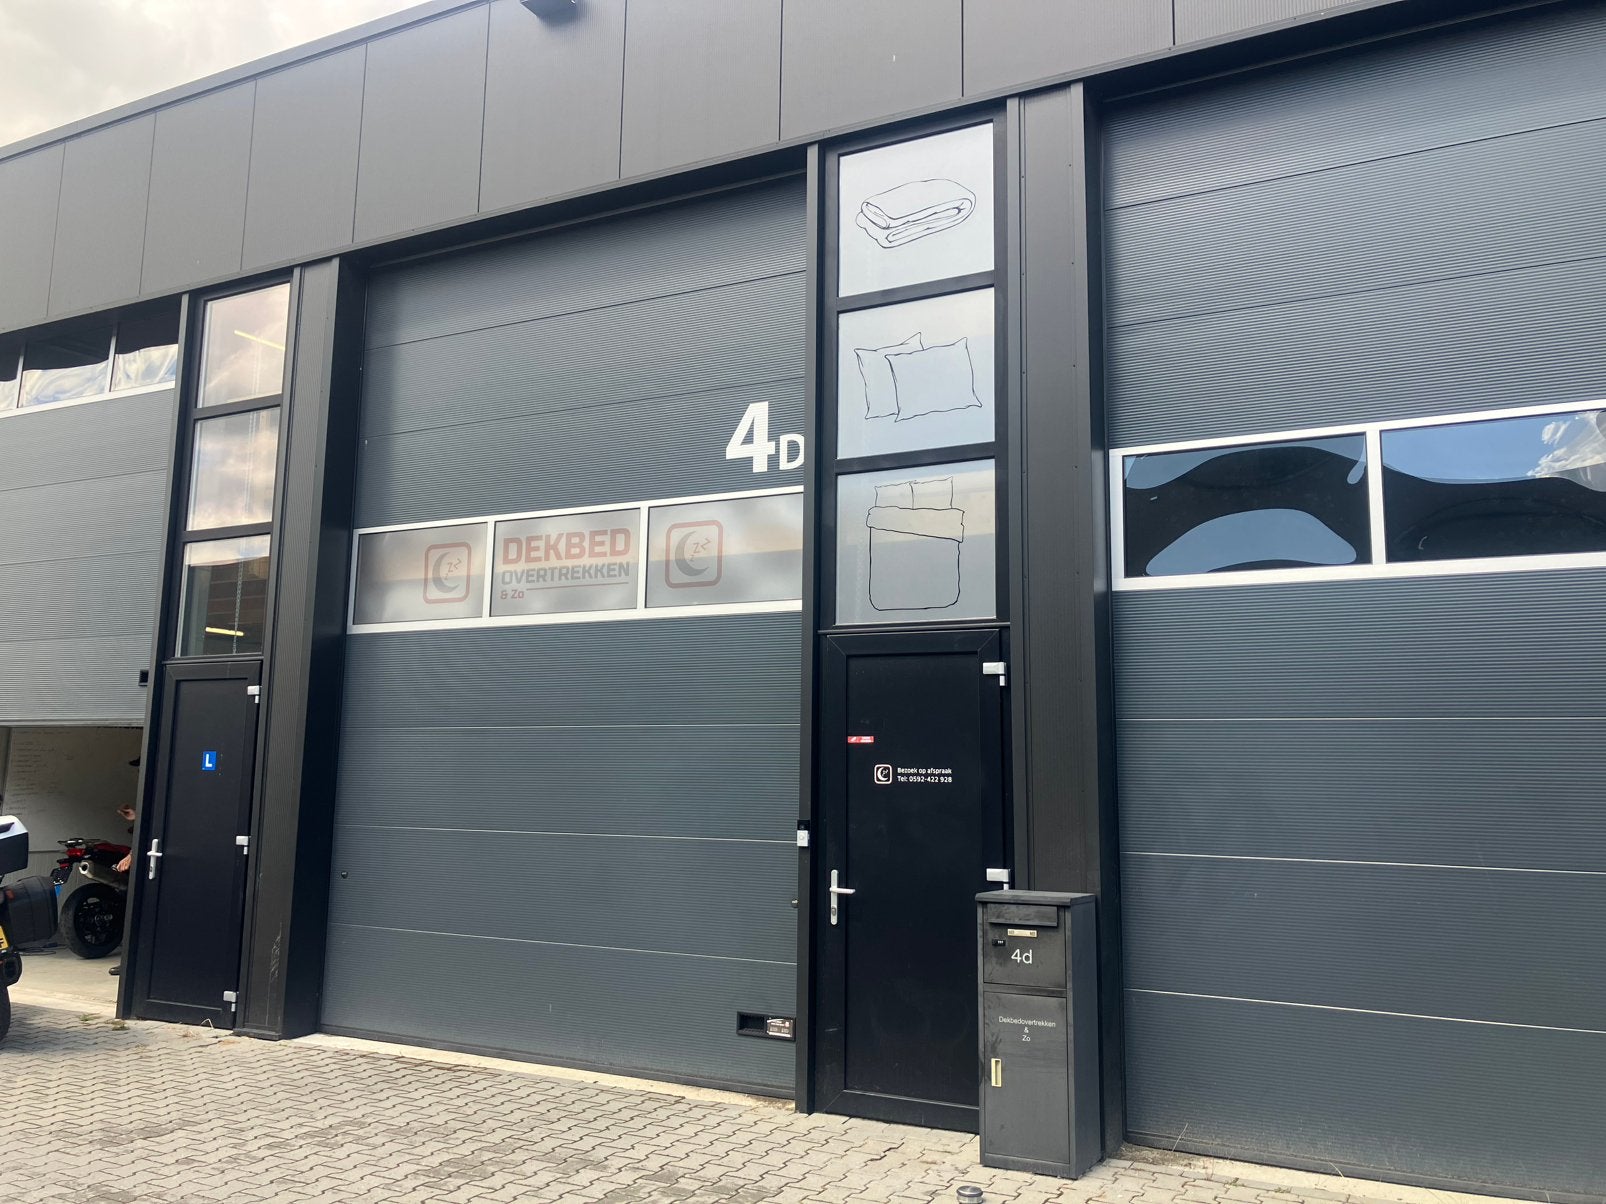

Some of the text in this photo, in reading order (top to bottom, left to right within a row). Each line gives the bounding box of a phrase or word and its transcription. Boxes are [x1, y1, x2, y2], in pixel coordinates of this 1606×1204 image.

[726, 401, 804, 473] 4D
[503, 528, 630, 564] DEKBED
[502, 562, 630, 585] OVERTREKKEN
[500, 588, 525, 600] & Zo
[206, 754, 213, 767] L
[1011, 949, 1032, 964] 4d
[999, 1016, 1056, 1027] Dekbedovertrekken
